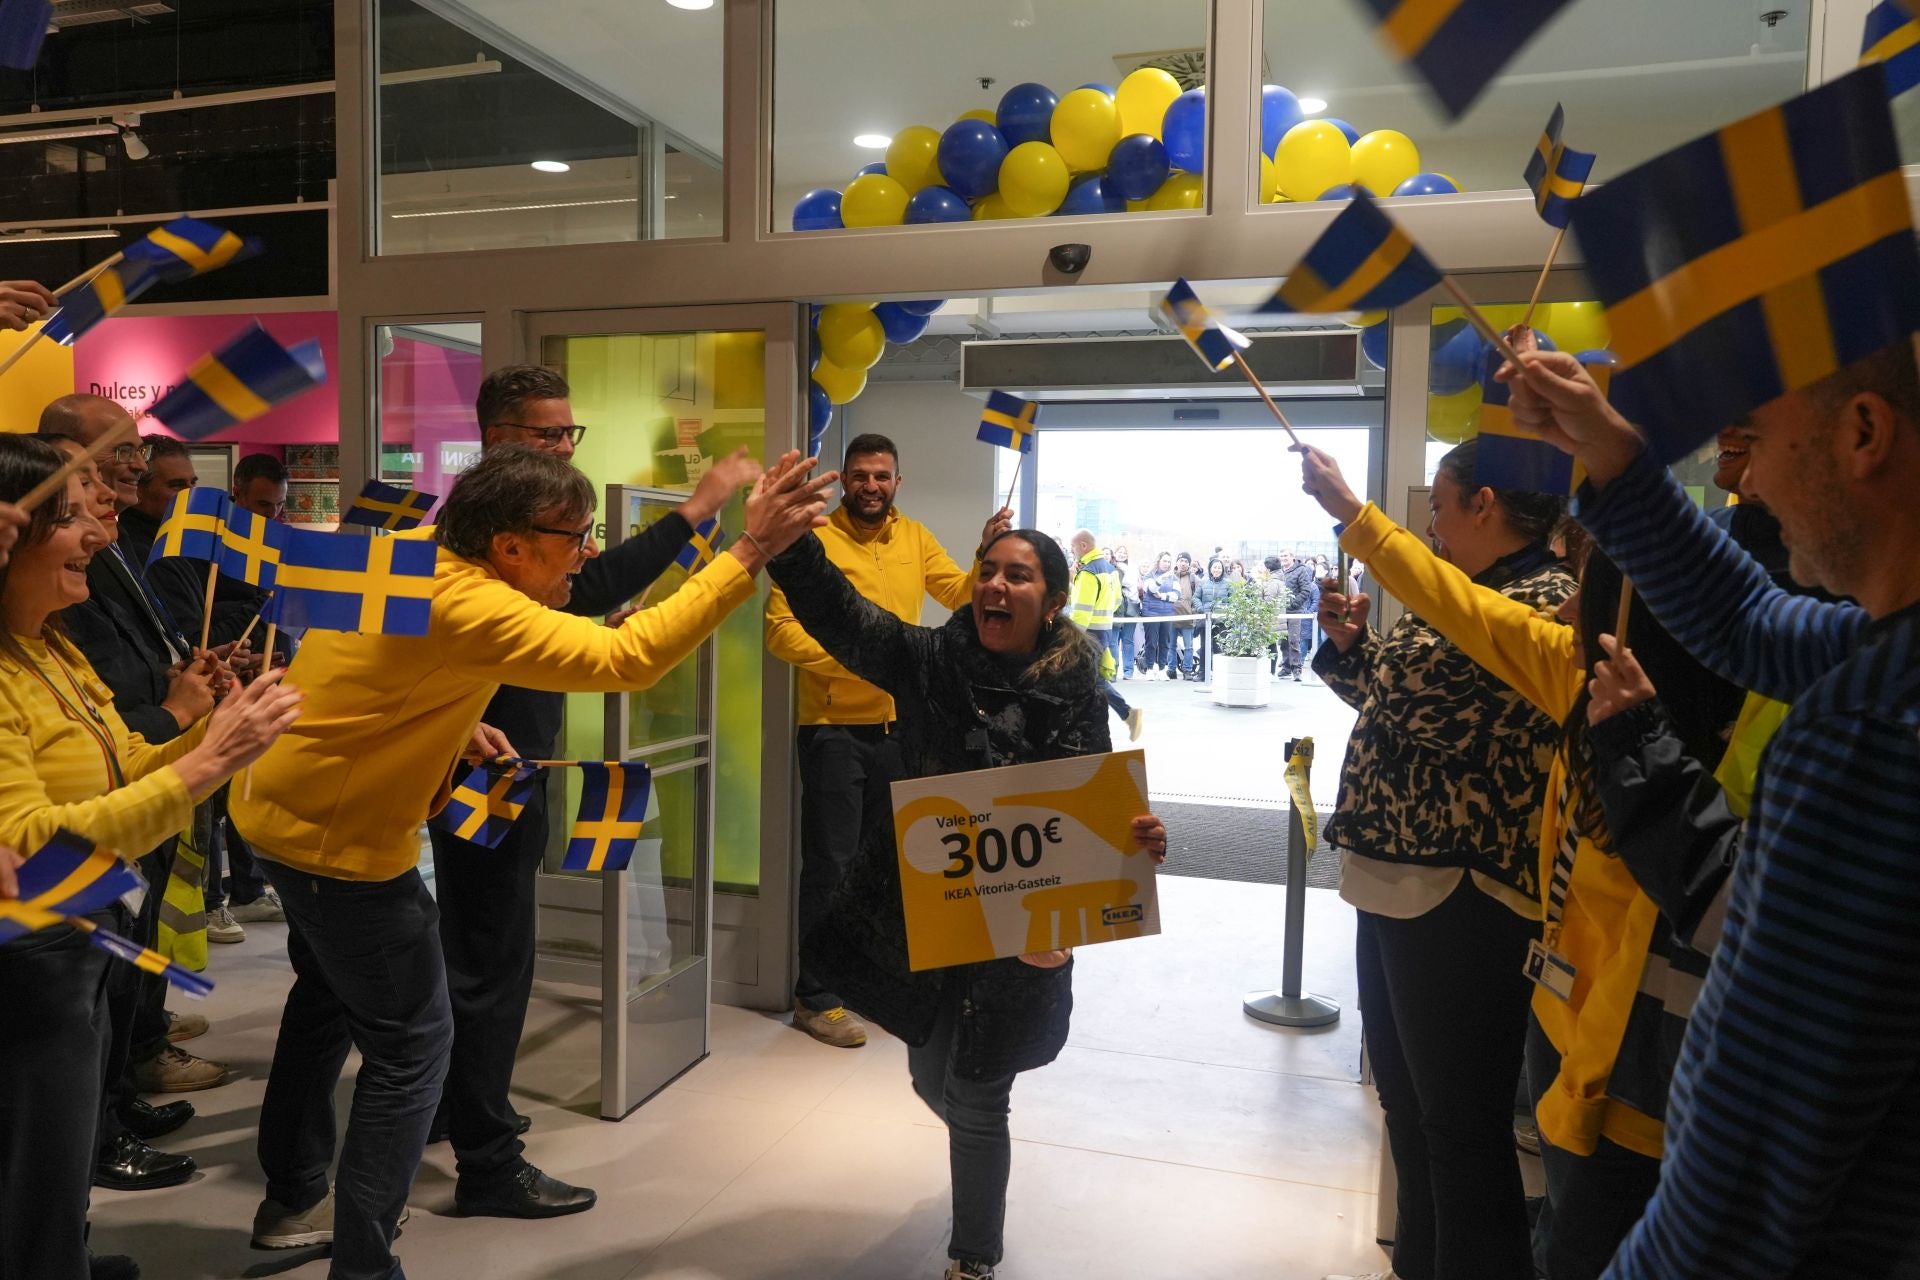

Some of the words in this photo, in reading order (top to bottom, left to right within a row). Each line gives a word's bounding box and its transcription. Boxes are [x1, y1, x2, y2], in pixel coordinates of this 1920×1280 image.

[90, 382, 146, 399] Dulces
[151, 385, 161, 403] y
[936, 814, 966, 828] Vale
[969, 812, 992, 829] por
[940, 817, 1063, 878] 300€
[944, 887, 973, 900] IKEA
[974, 875, 1062, 897] Vitoria-Gasteiz
